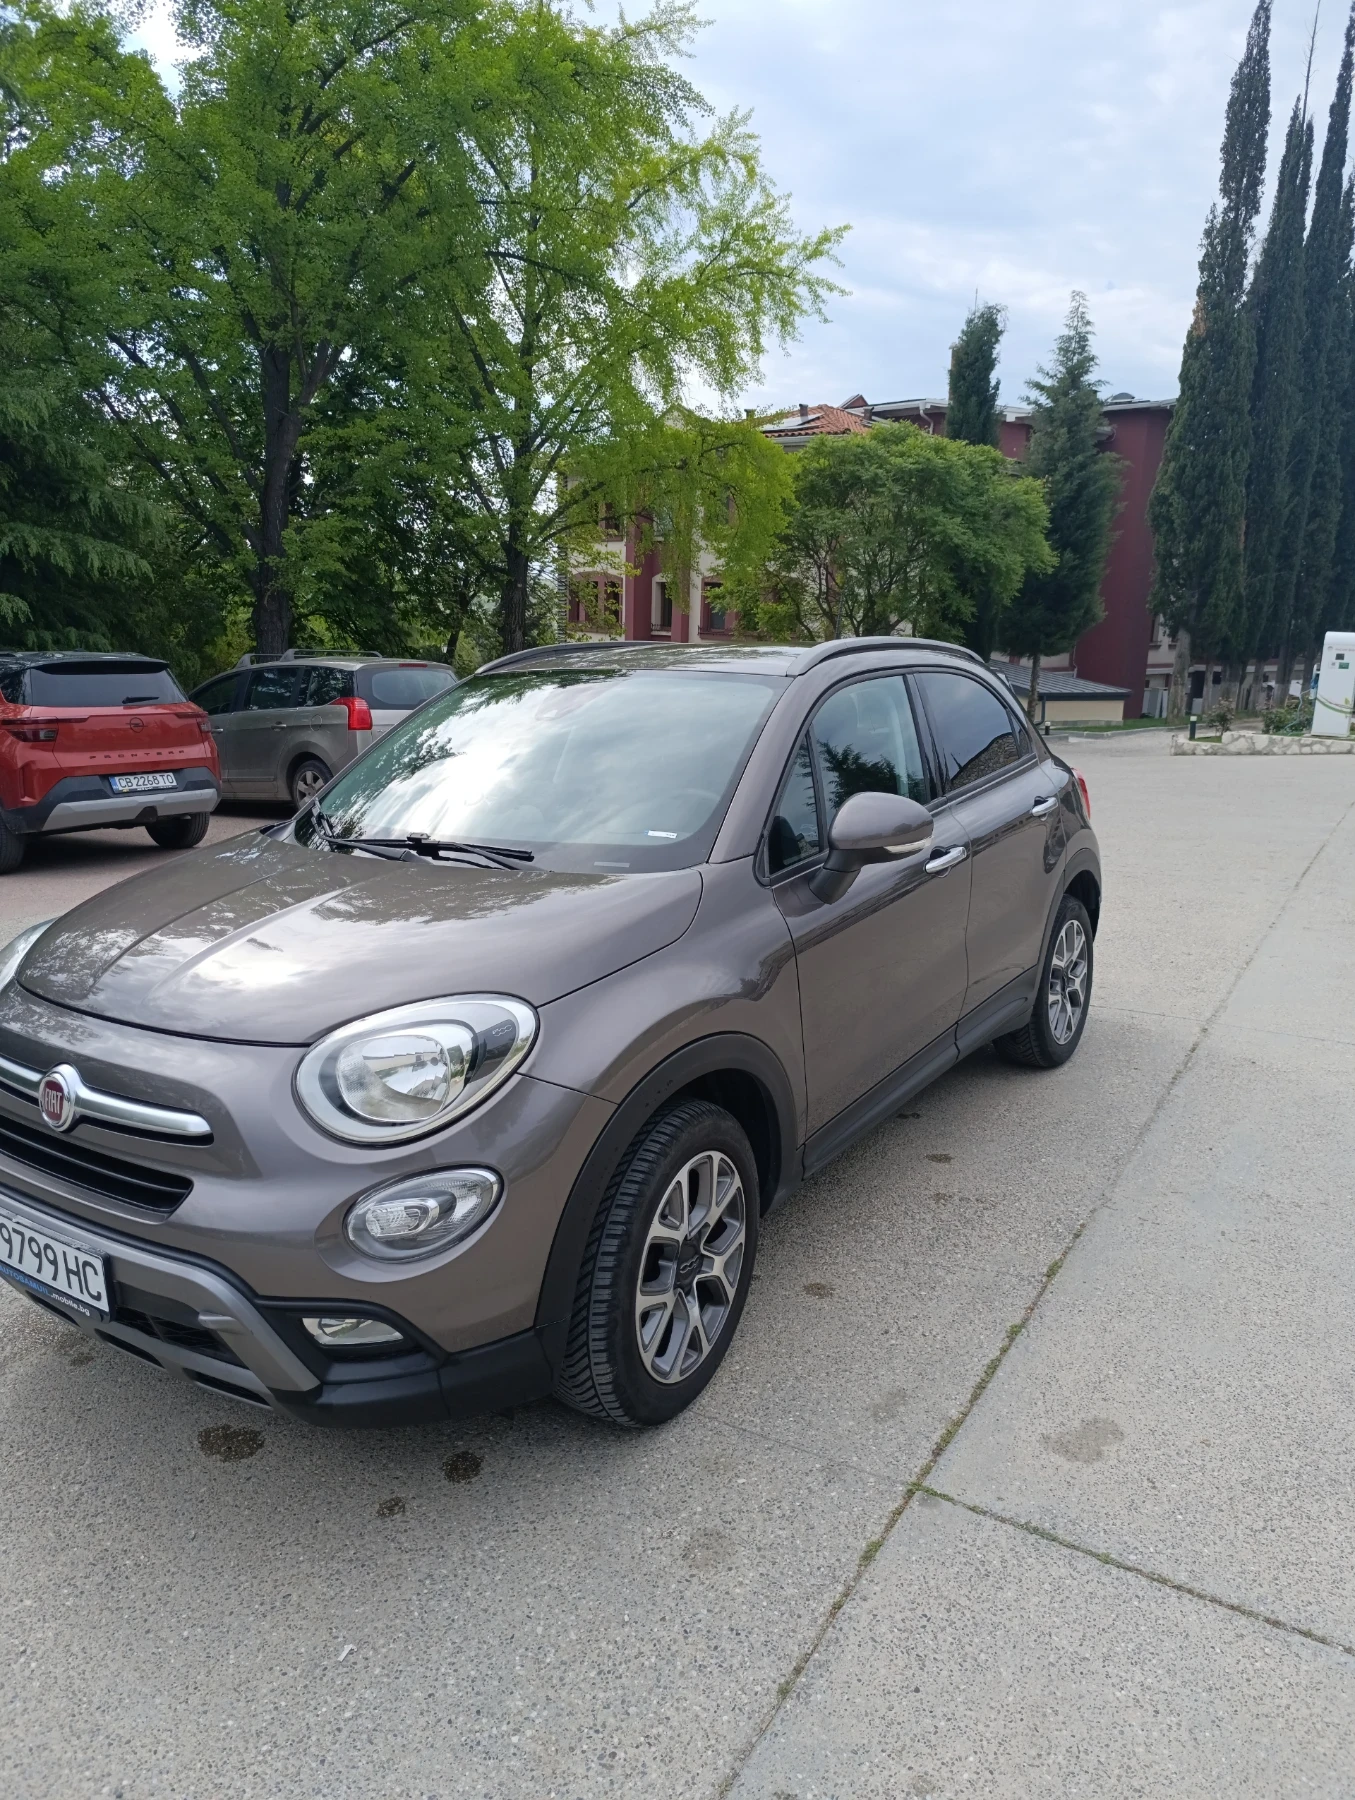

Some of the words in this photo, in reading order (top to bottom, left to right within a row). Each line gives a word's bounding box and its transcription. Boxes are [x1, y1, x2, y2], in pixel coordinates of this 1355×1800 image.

[117, 777, 134, 789] CB
[135, 775, 160, 788] 2268
[161, 773, 175, 785] TO
[45, 1087, 62, 1114] FIAT
[0, 1222, 59, 1282] 9799
[62, 1250, 102, 1302] HC
